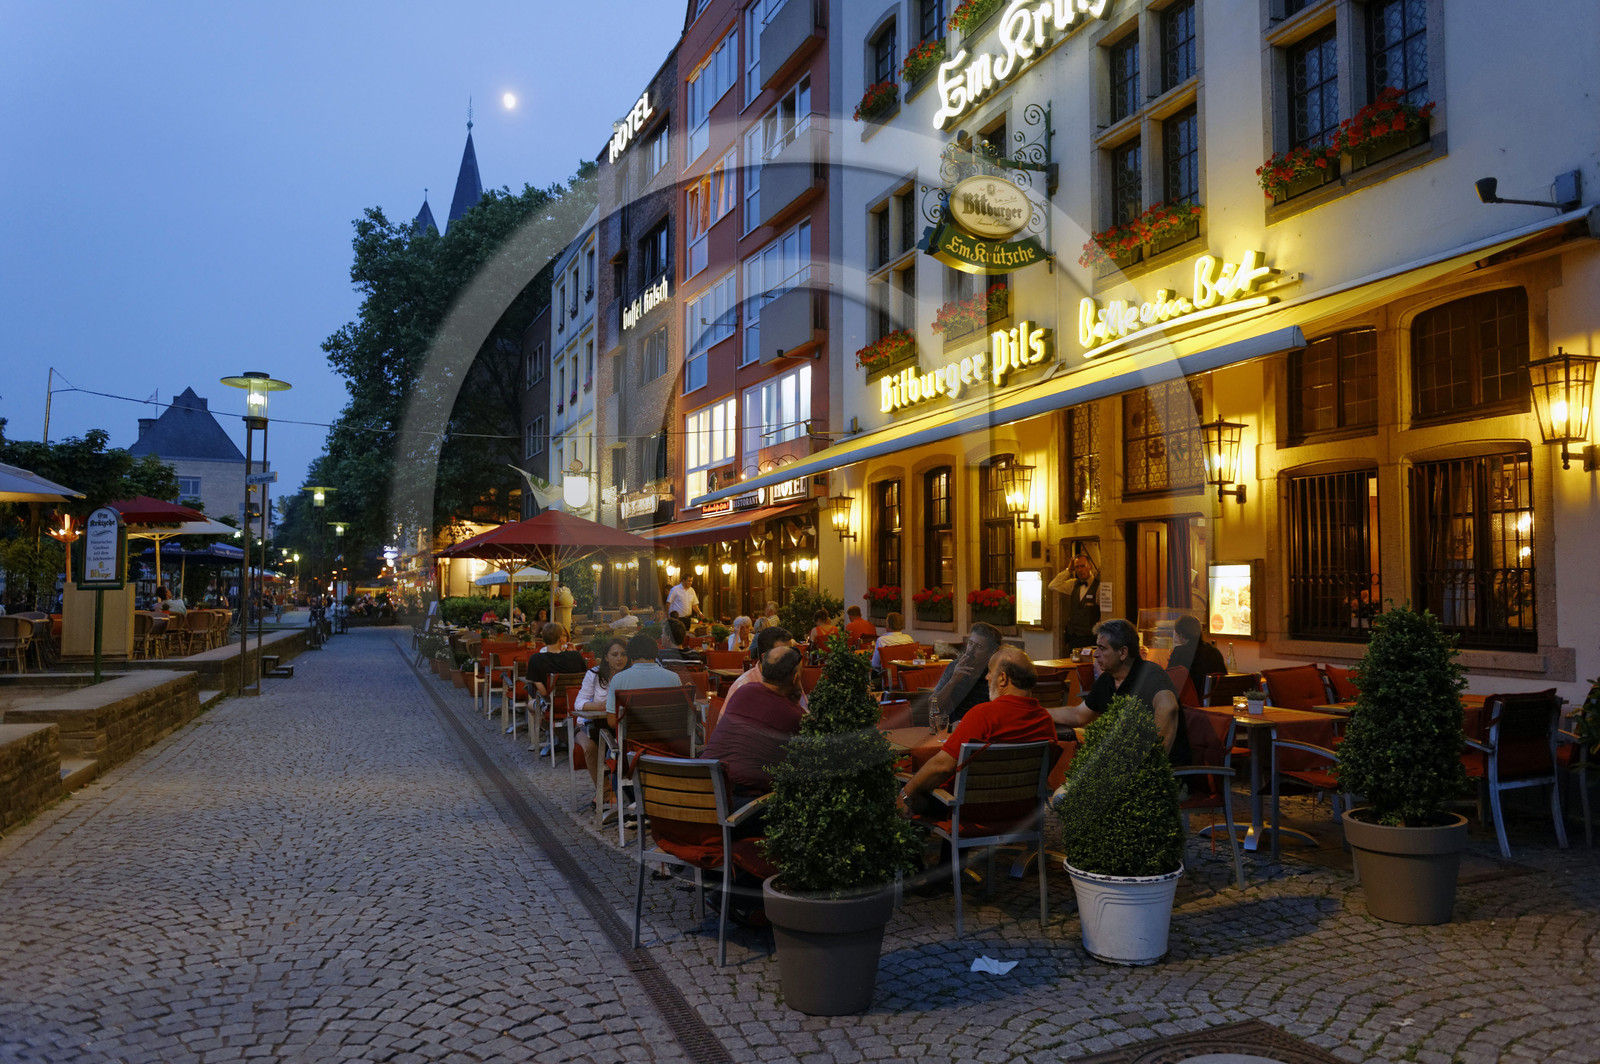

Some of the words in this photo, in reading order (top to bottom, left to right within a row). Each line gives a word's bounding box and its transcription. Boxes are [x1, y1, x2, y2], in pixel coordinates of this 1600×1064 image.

[933, 49, 992, 130] Em
[609, 92, 653, 164] HOTEL
[962, 192, 1022, 220] Bitburger
[946, 236, 970, 259] Em
[970, 242, 1036, 266] Krützche
[623, 295, 643, 330] Gaffel
[643, 274, 668, 314] Kölsch
[1079, 297, 1140, 348] Bitte
[1140, 288, 1195, 323] ein
[1193, 250, 1271, 308] Bit
[880, 351, 986, 413] Bitburger
[992, 320, 1047, 387] Pils
[774, 478, 806, 497] HOTEL
